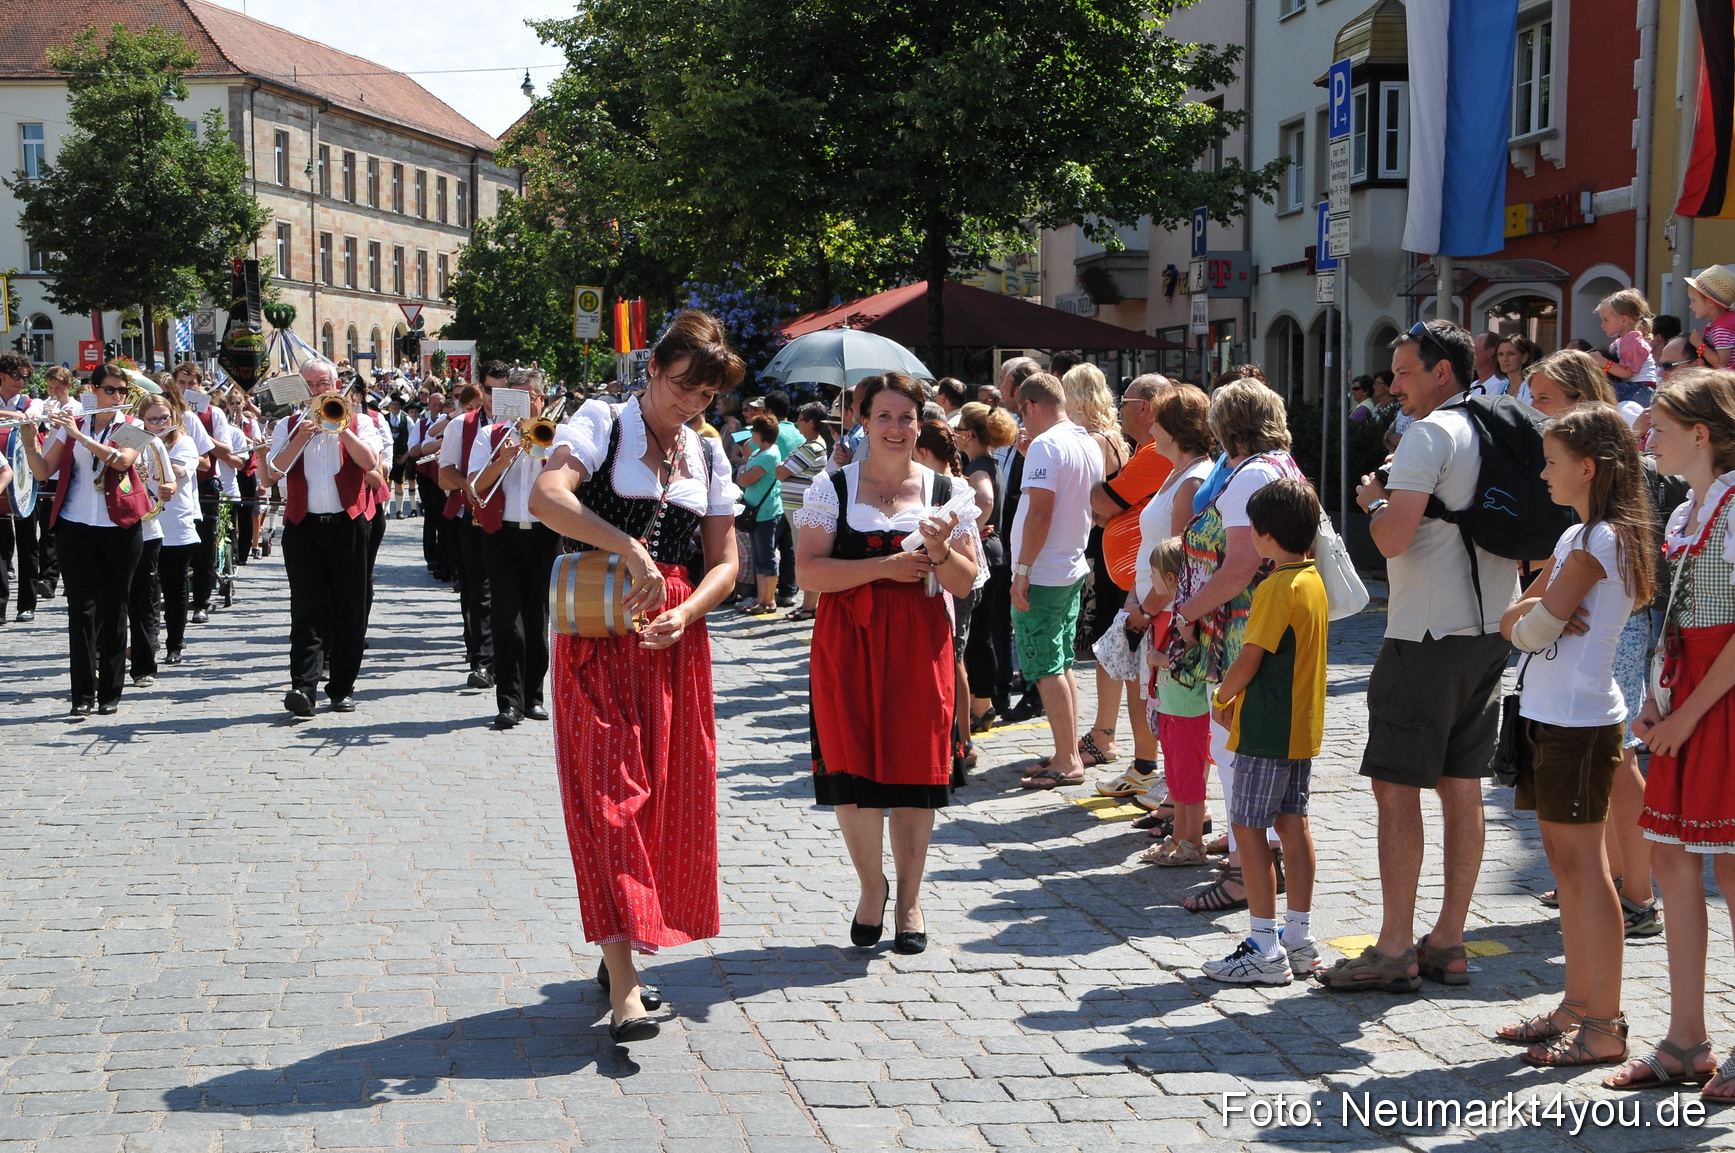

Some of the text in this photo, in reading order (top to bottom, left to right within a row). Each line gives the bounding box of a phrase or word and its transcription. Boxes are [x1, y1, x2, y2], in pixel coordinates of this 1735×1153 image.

[1334, 71, 1346, 129] P
[1194, 214, 1204, 252] P
[634, 350, 649, 360] WC
